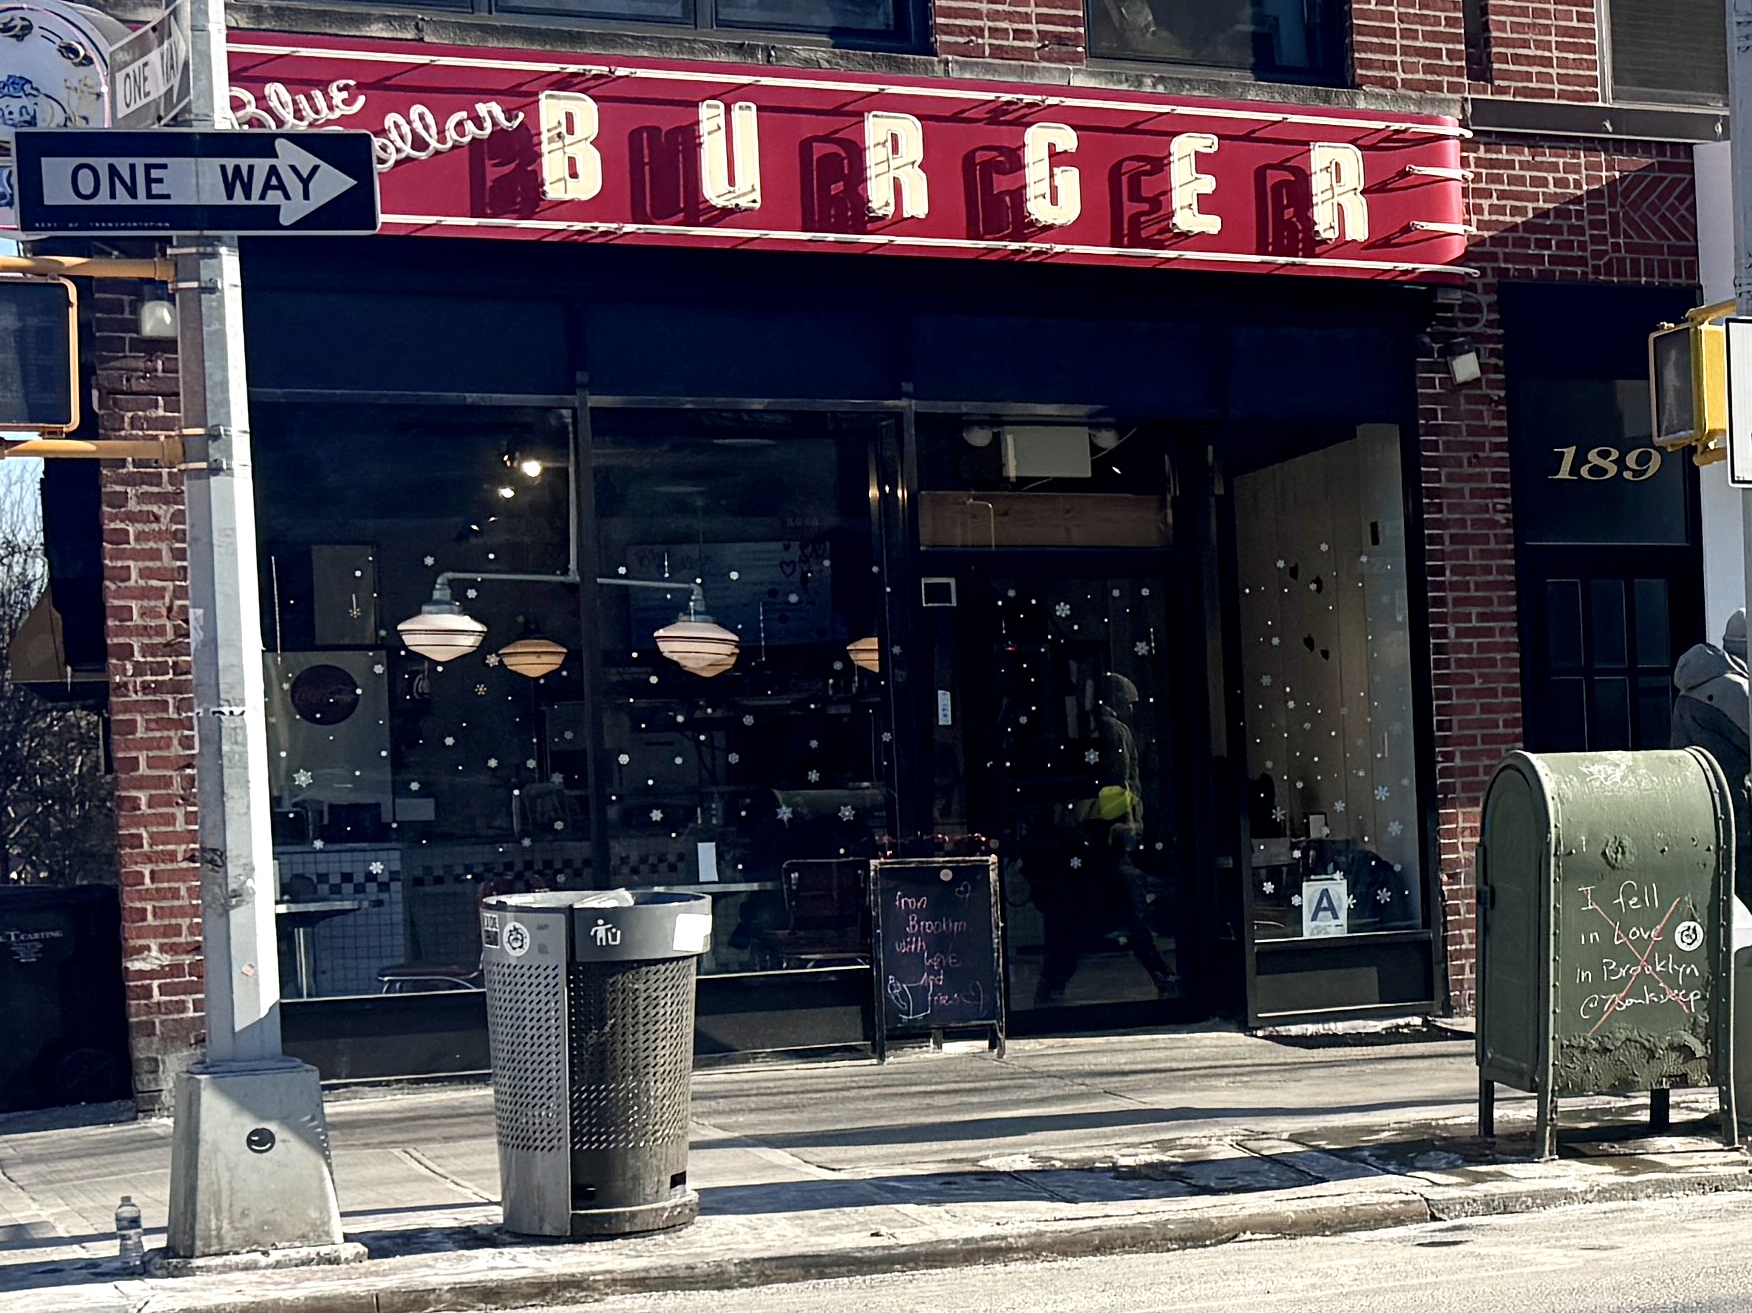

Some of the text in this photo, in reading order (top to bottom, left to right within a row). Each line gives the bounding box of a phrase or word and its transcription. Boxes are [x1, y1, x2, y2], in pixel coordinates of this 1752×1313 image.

[123, 60, 151, 109] ONE
[373, 101, 525, 172] ollar
[70, 162, 321, 202] ONE WAY
[538, 89, 1370, 242] BURGER
[1546, 445, 1663, 482] 189
[1310, 887, 1340, 923] A
[1578, 880, 1660, 914] I fell
[1581, 921, 1663, 945] in Love
[1576, 952, 1700, 985] in Brooklyn
